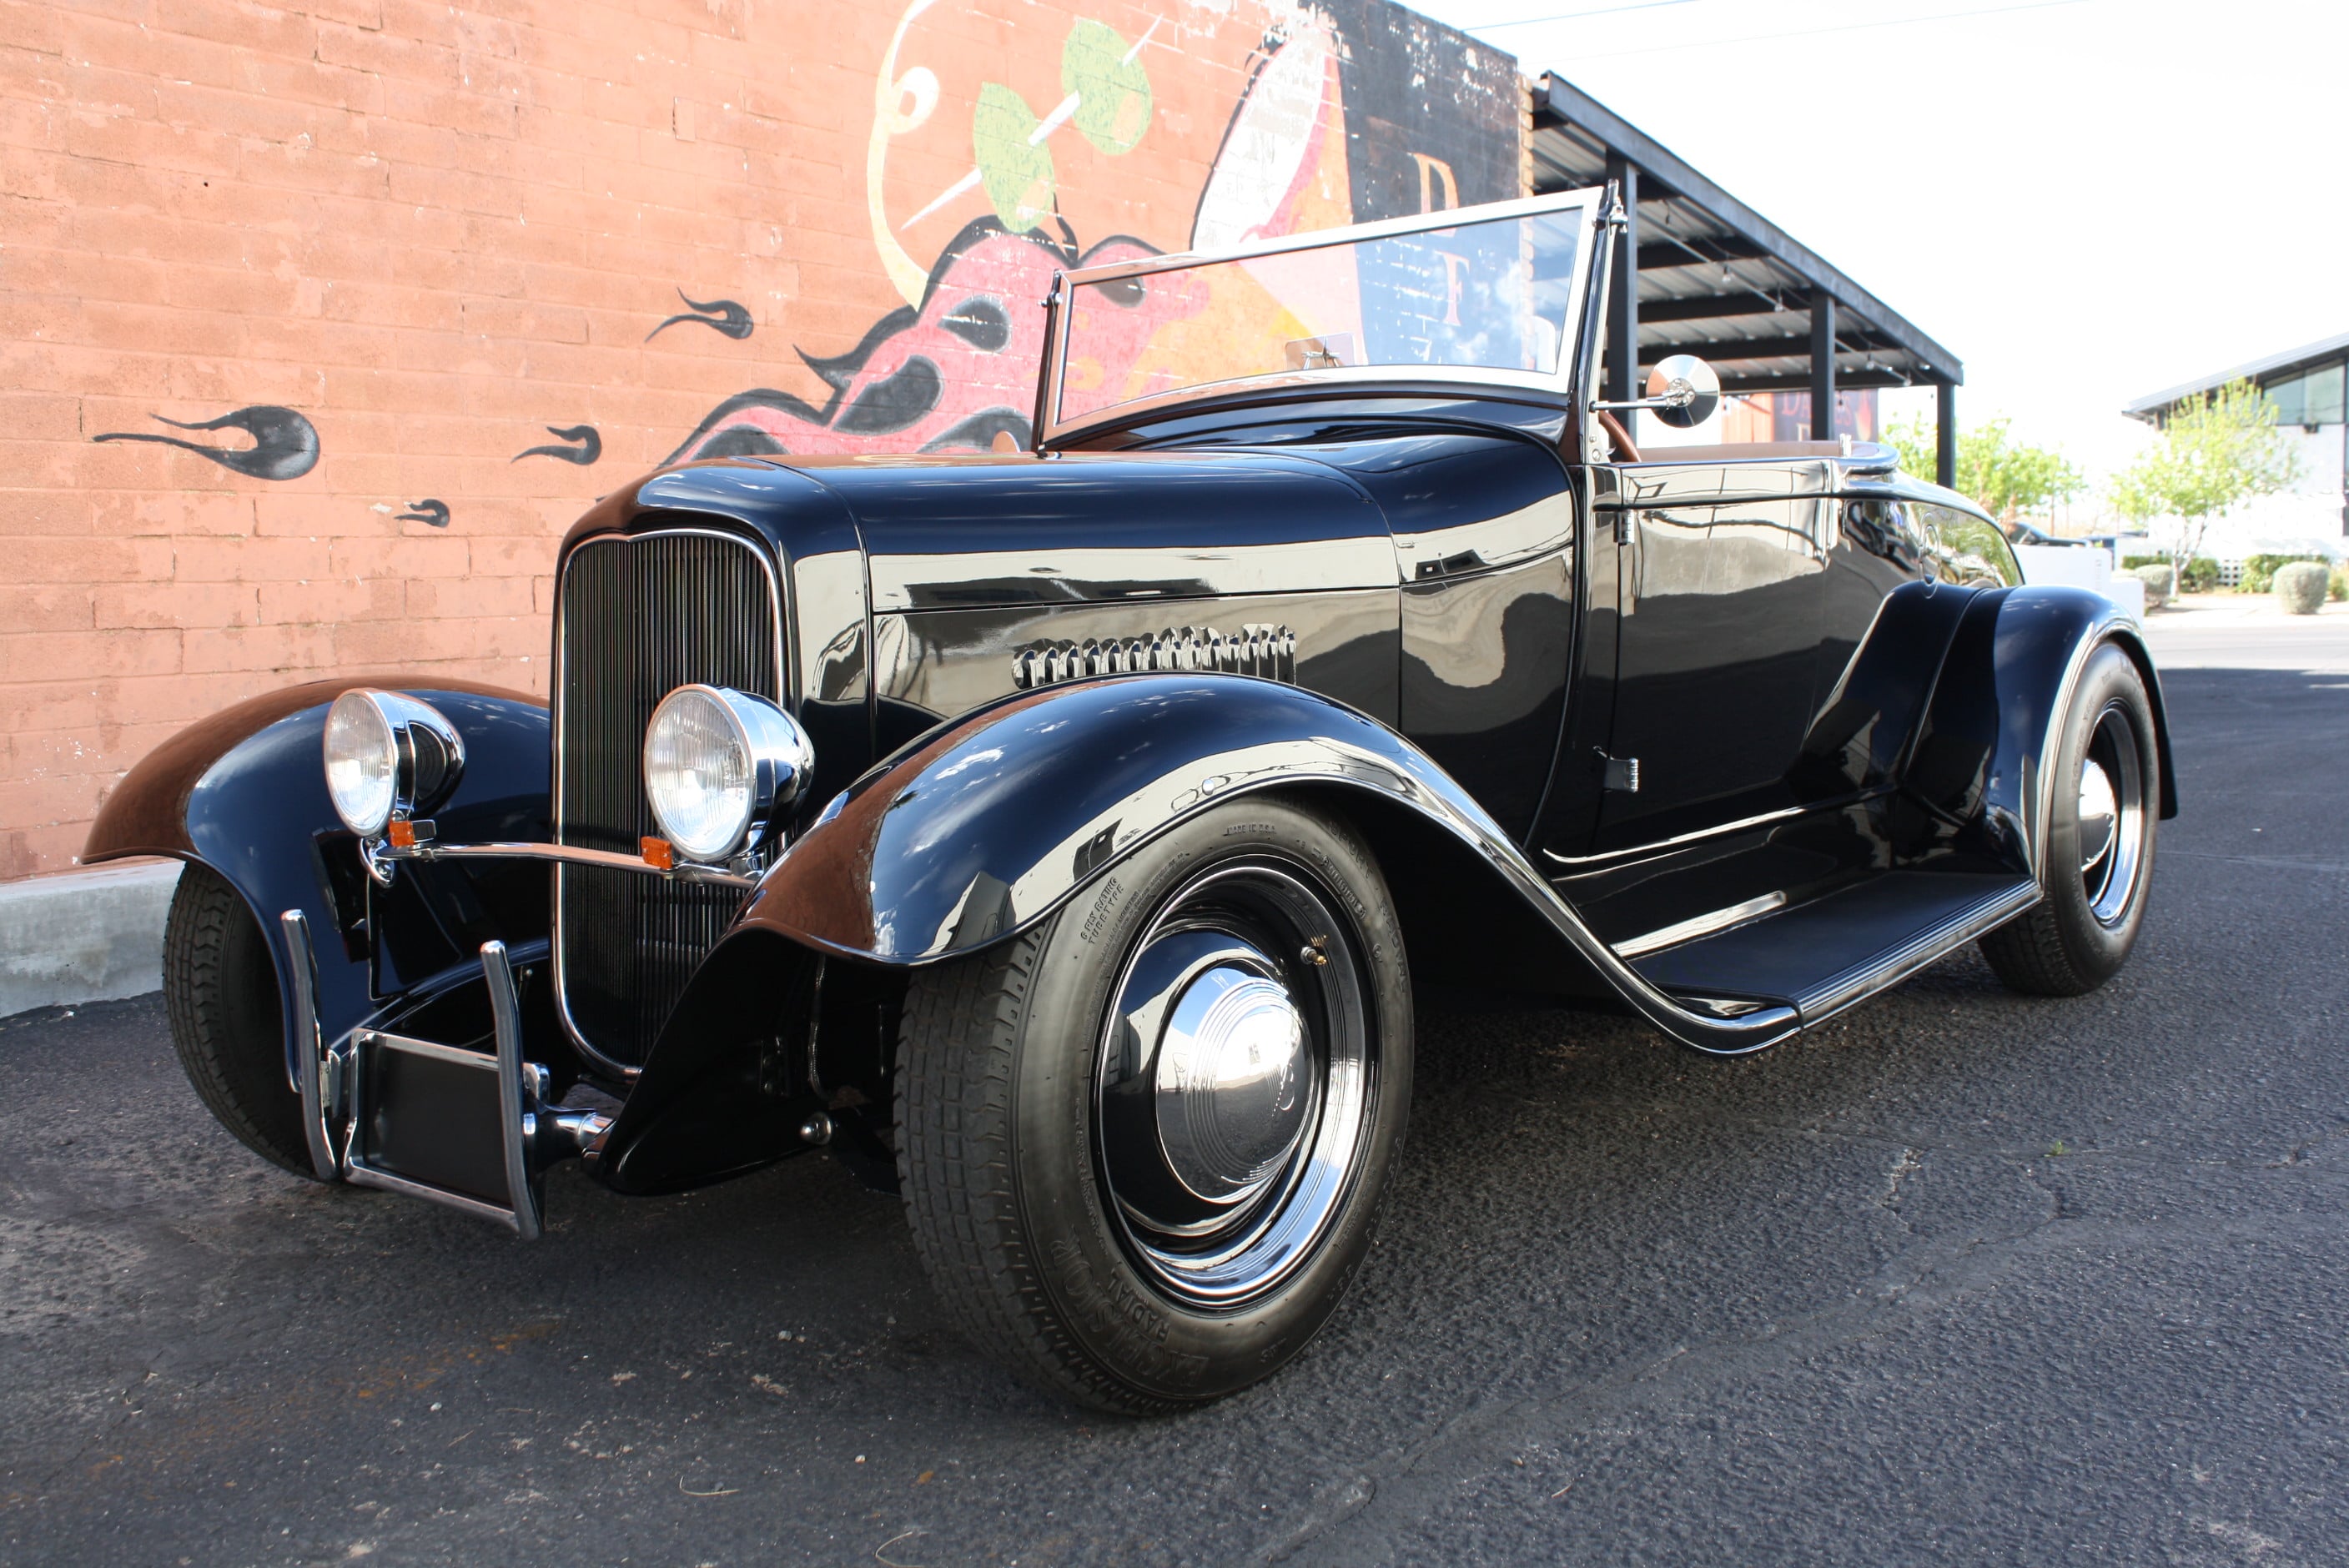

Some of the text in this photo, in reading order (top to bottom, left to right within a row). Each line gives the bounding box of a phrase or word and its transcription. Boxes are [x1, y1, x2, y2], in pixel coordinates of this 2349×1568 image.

[1094, 877, 1119, 915] RATING
[1049, 1224, 1211, 1388] EXCELSIOR
[1110, 1261, 1170, 1339] RADIAL
